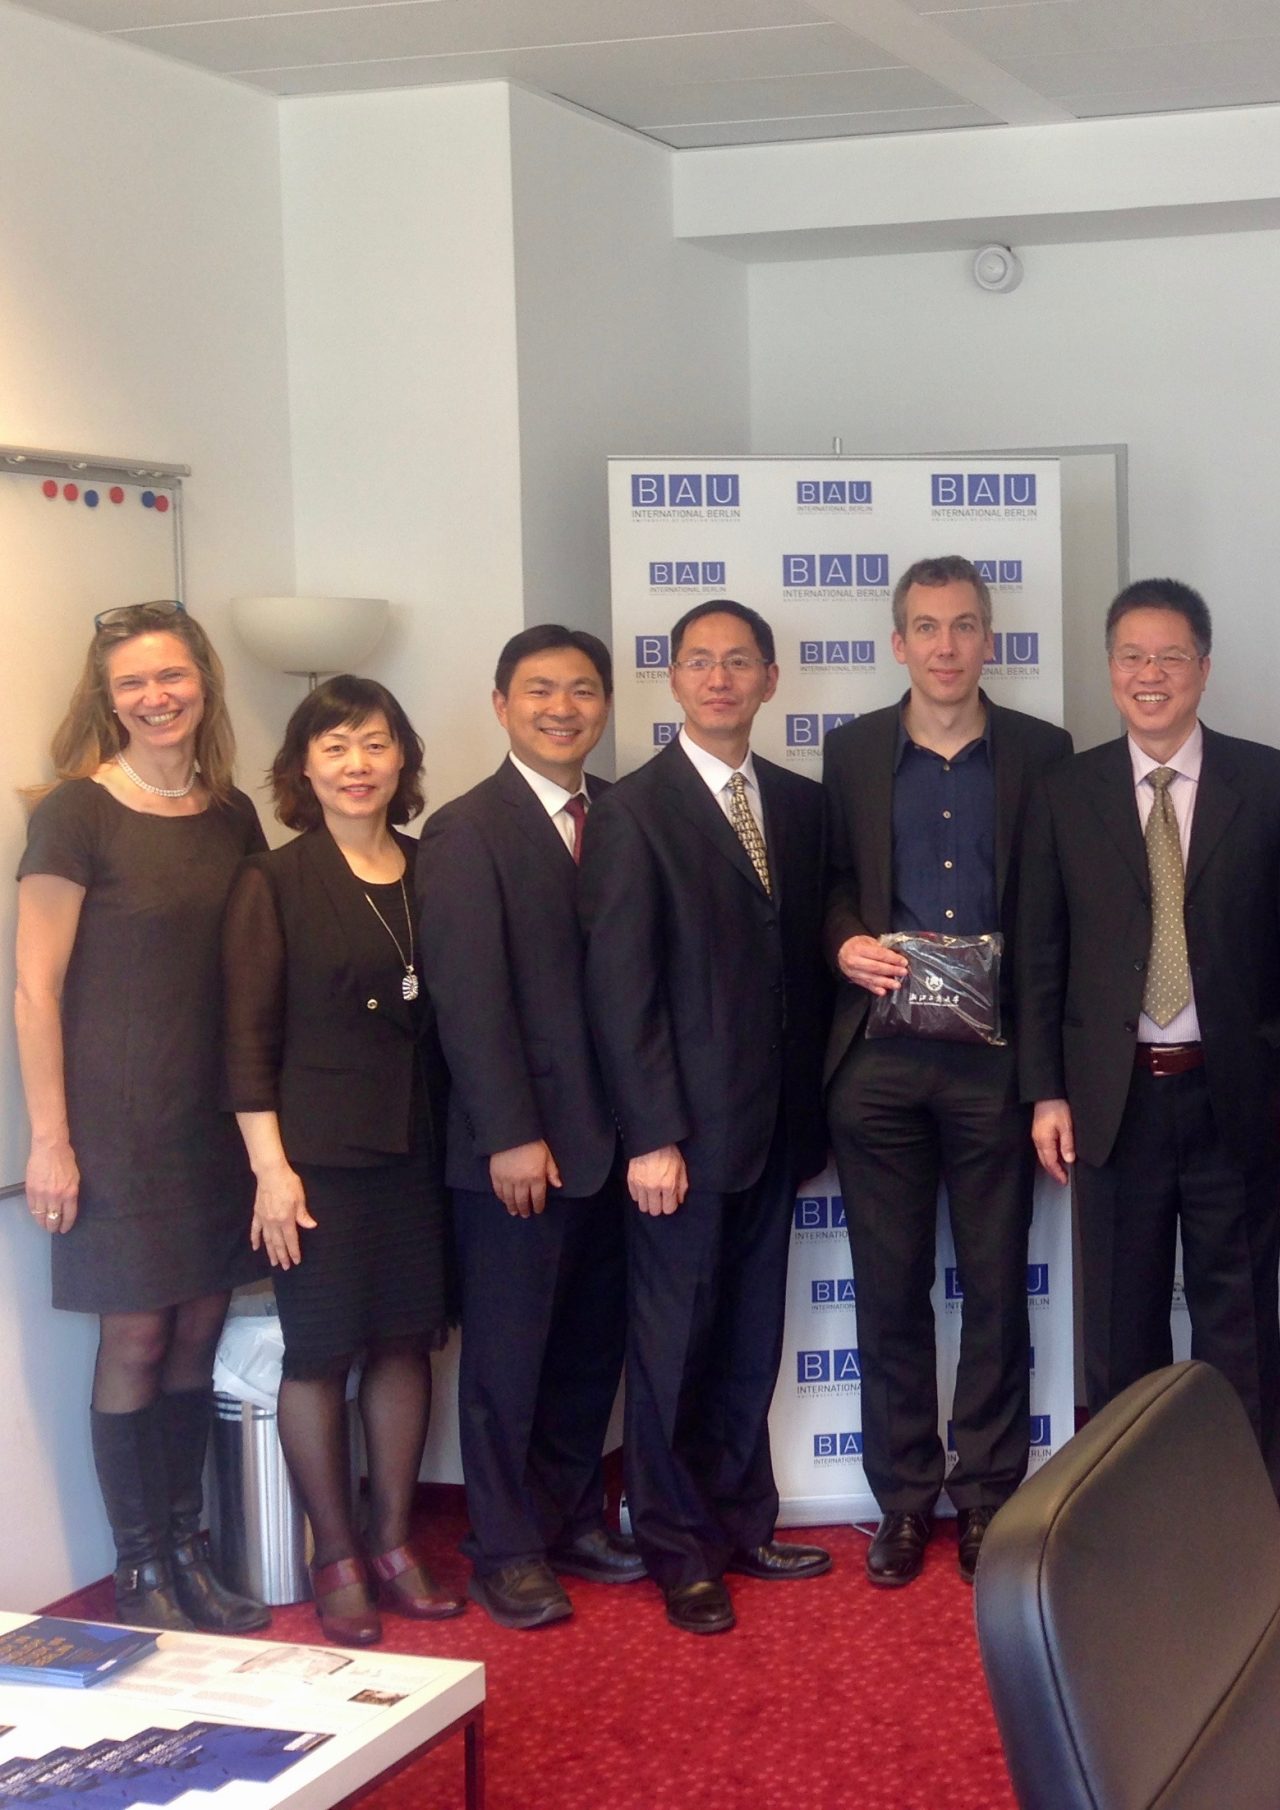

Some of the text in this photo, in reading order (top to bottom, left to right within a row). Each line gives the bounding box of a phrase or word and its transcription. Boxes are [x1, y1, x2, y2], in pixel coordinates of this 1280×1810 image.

[635, 476, 737, 506] BAU
[798, 482, 870, 503] BAU
[934, 475, 1034, 505] BAU
[632, 509, 740, 518] INTERNATIONAL BERLIN
[931, 508, 1037, 517] INTERNATIONAL BERLIN
[651, 563, 724, 584] BAU
[784, 555, 886, 586] BAU
[977, 562, 1020, 581] AU
[783, 589, 890, 598] INTERNATIONAL BERLIN
[802, 642, 874, 663] BAU
[1007, 667, 1040, 676] BERLIN
[795, 1230, 848, 1240] INTERNATIO
[814, 1280, 856, 1301] BA
[812, 1302, 856, 1311] INTERNATION
[1028, 1297, 1050, 1306] RLIN
[800, 1351, 861, 1381] BA
[816, 1434, 861, 1455] BA
[1029, 1448, 1052, 1457] RLIN
